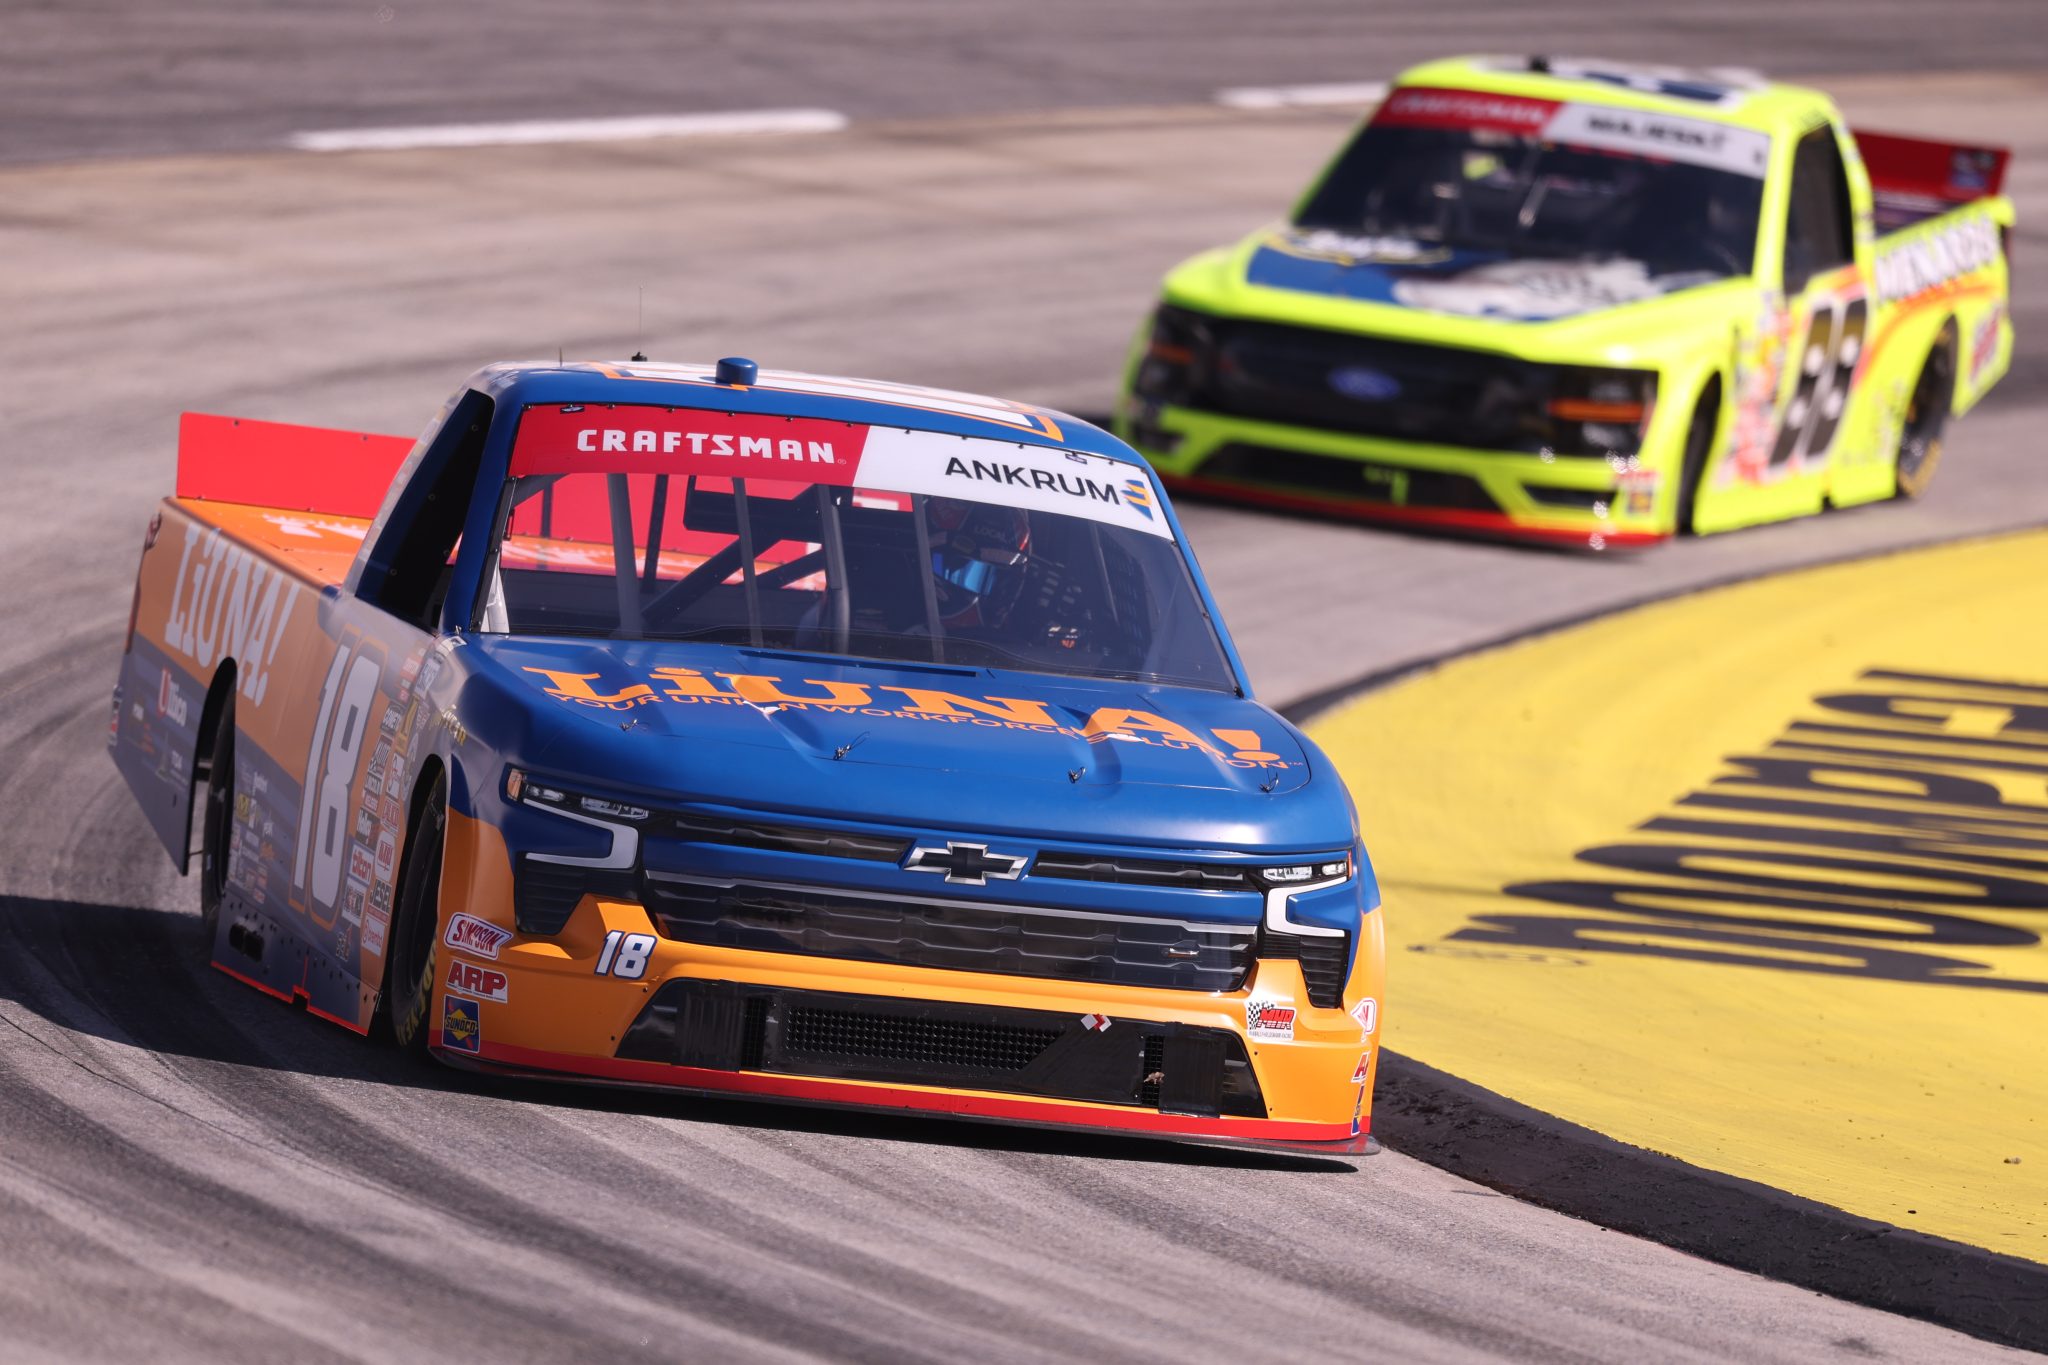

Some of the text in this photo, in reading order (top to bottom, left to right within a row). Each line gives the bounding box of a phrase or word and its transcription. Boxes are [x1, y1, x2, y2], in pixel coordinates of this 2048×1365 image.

[577, 429, 835, 464] CRAFTSMAN
[945, 457, 1120, 506] ANKRUM
[547, 692, 665, 711] YOUR
[815, 703, 1080, 741] WORKFORCE
[293, 643, 381, 909] 18
[452, 919, 505, 953] SIMPSON
[594, 929, 657, 980] 18
[447, 961, 507, 995] ARP
[446, 1016, 477, 1034] SUNOCO
